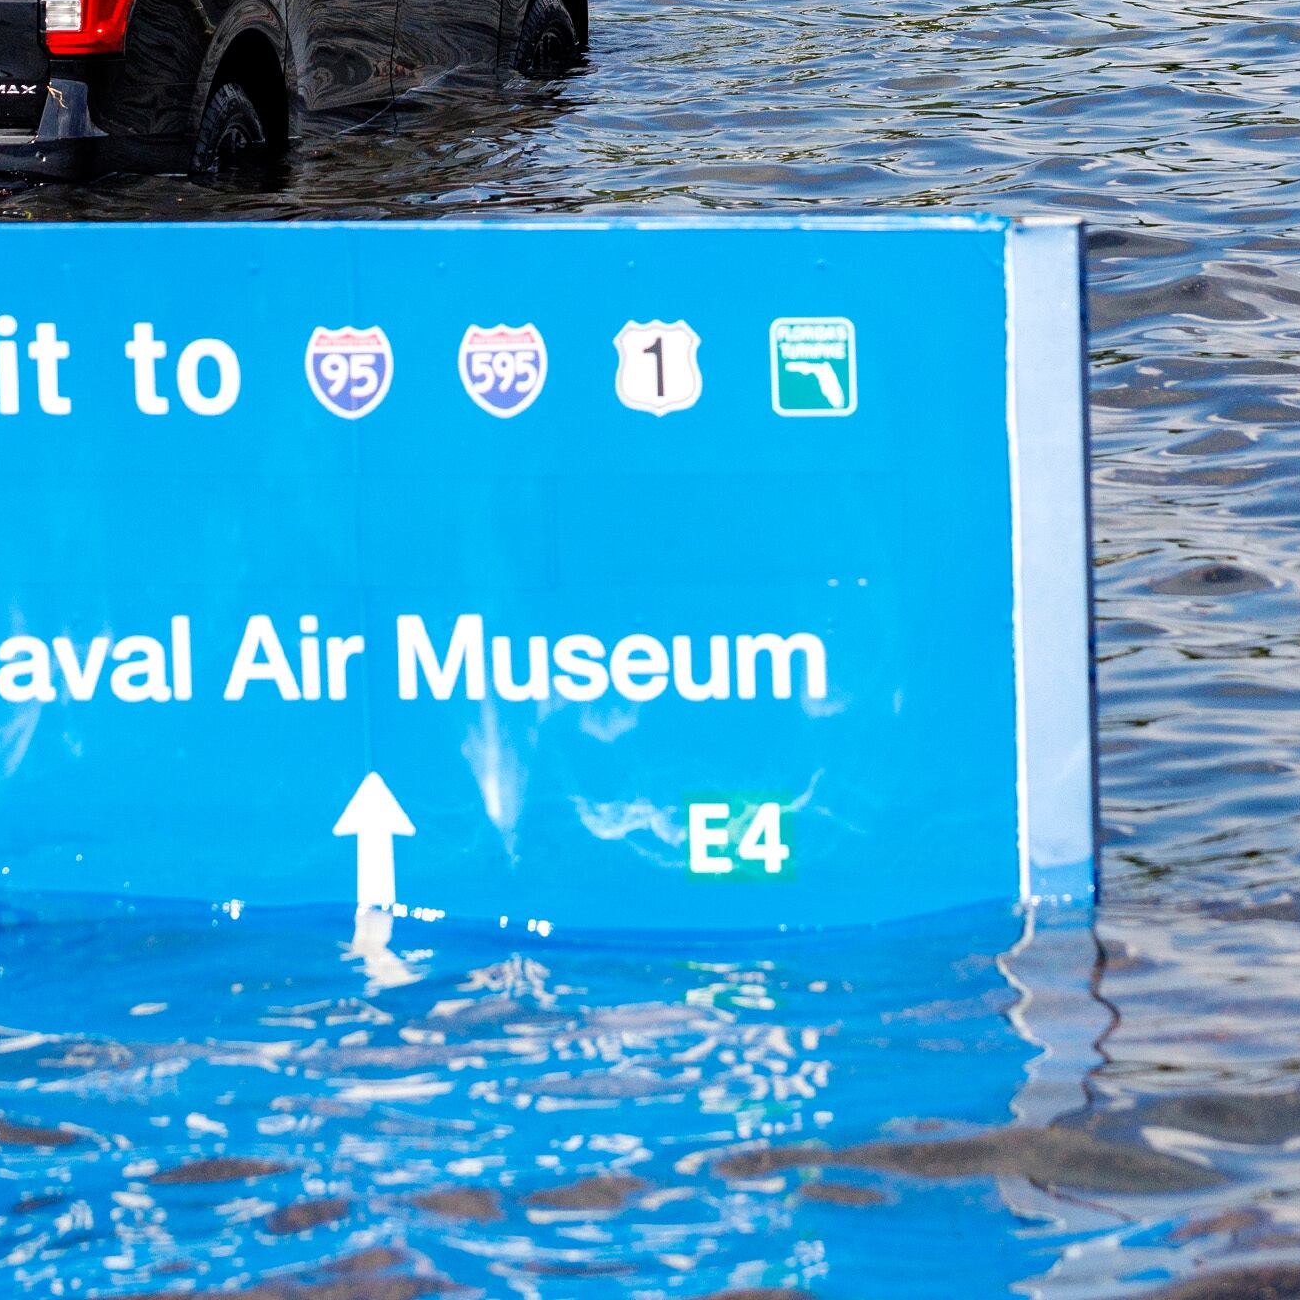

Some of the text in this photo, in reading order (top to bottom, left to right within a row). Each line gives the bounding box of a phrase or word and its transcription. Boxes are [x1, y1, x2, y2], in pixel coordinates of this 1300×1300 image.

[124, 321, 242, 416] to
[319, 353, 379, 398] 95
[470, 351, 539, 394] 595
[642, 335, 665, 397] 1
[223, 614, 366, 702] Air
[396, 613, 828, 702] Museum
[688, 801, 791, 874] E4
